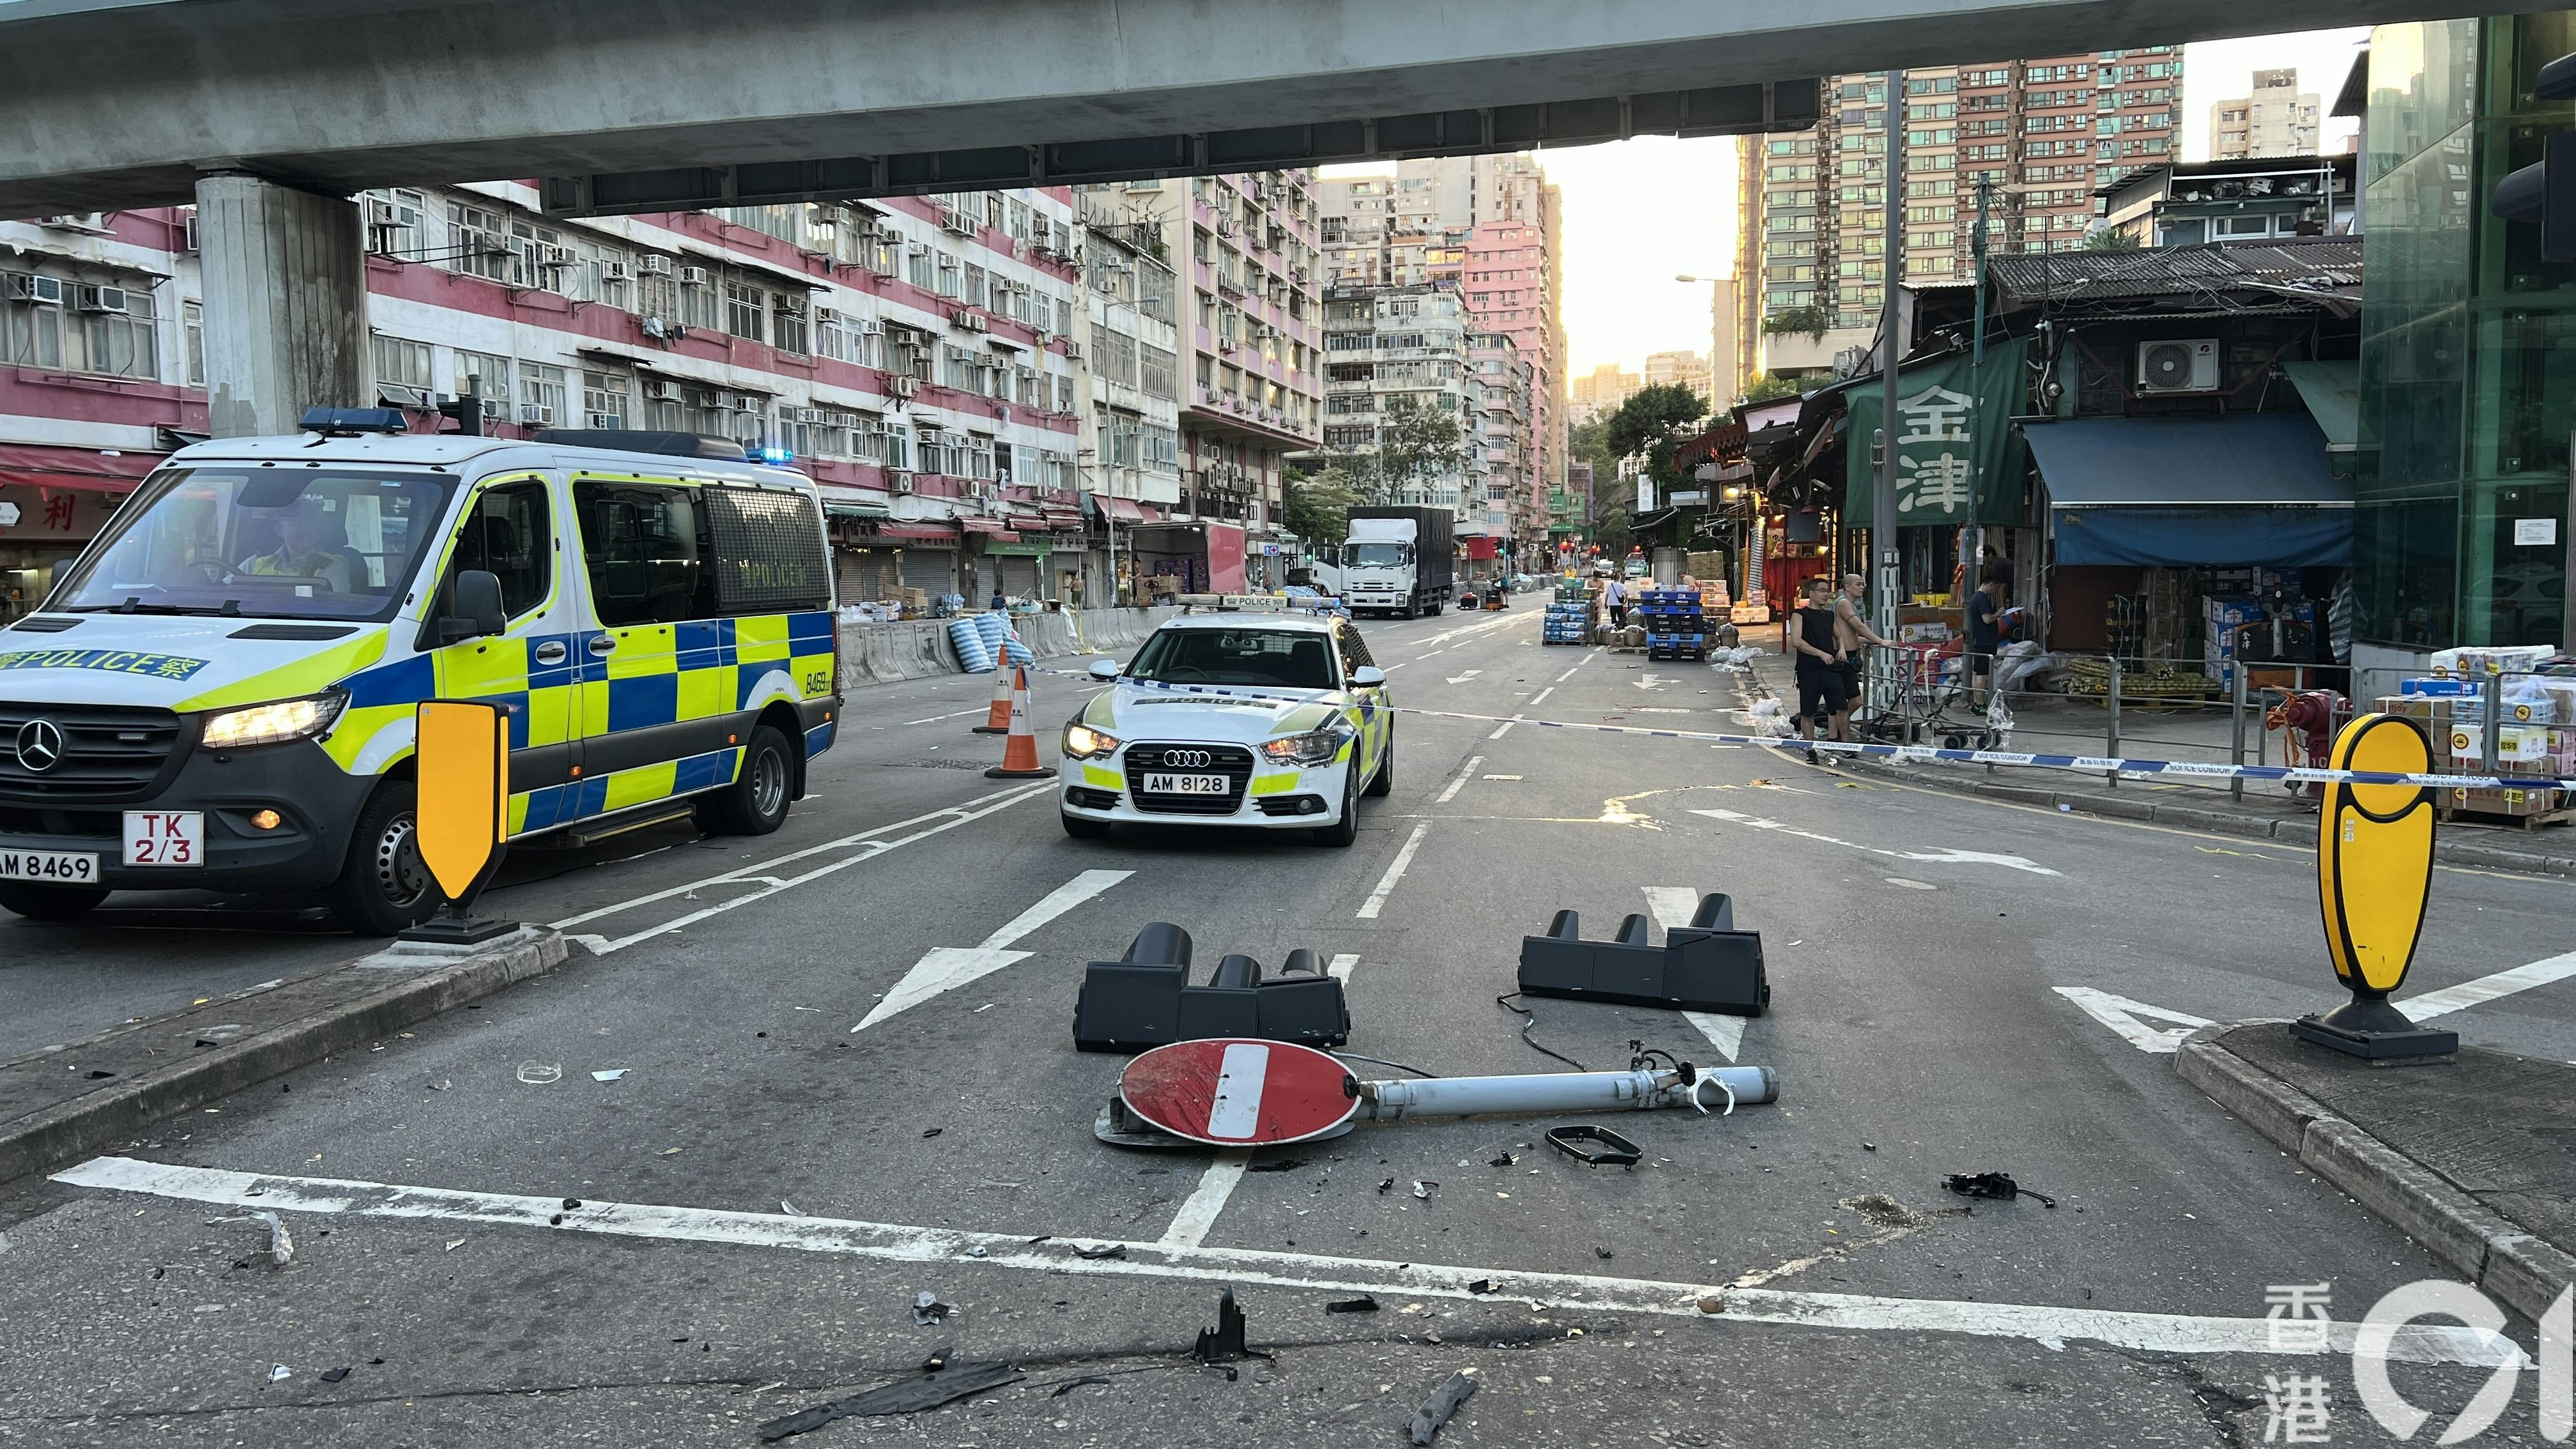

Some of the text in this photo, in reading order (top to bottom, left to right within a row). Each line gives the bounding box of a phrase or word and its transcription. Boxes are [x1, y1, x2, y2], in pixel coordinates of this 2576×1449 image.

[1896, 385, 1984, 513] 金津
[43, 494, 75, 532] 利
[14, 650, 166, 673] POLICE
[806, 671, 826, 694] 8469
[1165, 698, 1244, 706] POLICE
[1151, 776, 1223, 792] AM 8128
[142, 815, 183, 838] TK
[135, 839, 190, 862] 2/3
[0, 854, 90, 878] M 8469
